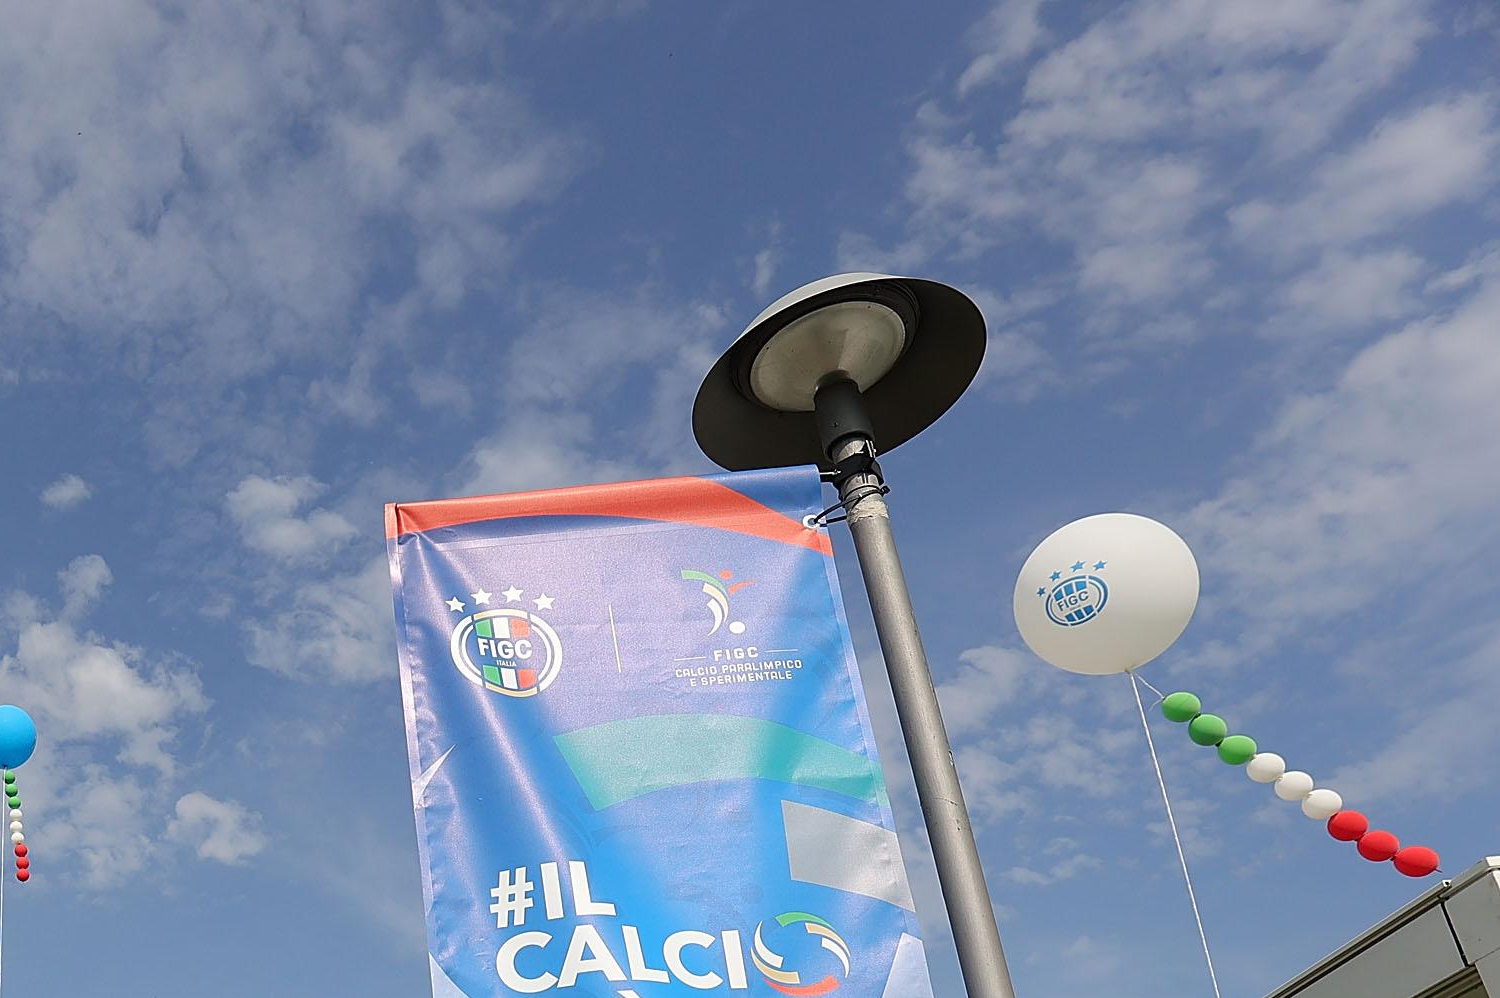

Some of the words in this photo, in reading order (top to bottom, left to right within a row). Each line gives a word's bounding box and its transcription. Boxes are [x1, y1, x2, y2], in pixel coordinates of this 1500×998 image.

[1057, 591, 1089, 611] FIGC
[477, 637, 533, 659] FIGC
[713, 646, 759, 662] FIGC
[496, 659, 517, 667] ITALIA
[675, 665, 718, 678] CALCIO
[722, 659, 803, 674] PARALIMPICO
[690, 678, 697, 687] E
[701, 670, 793, 686] SPERIMENTALE
[489, 860, 617, 929] #IL
